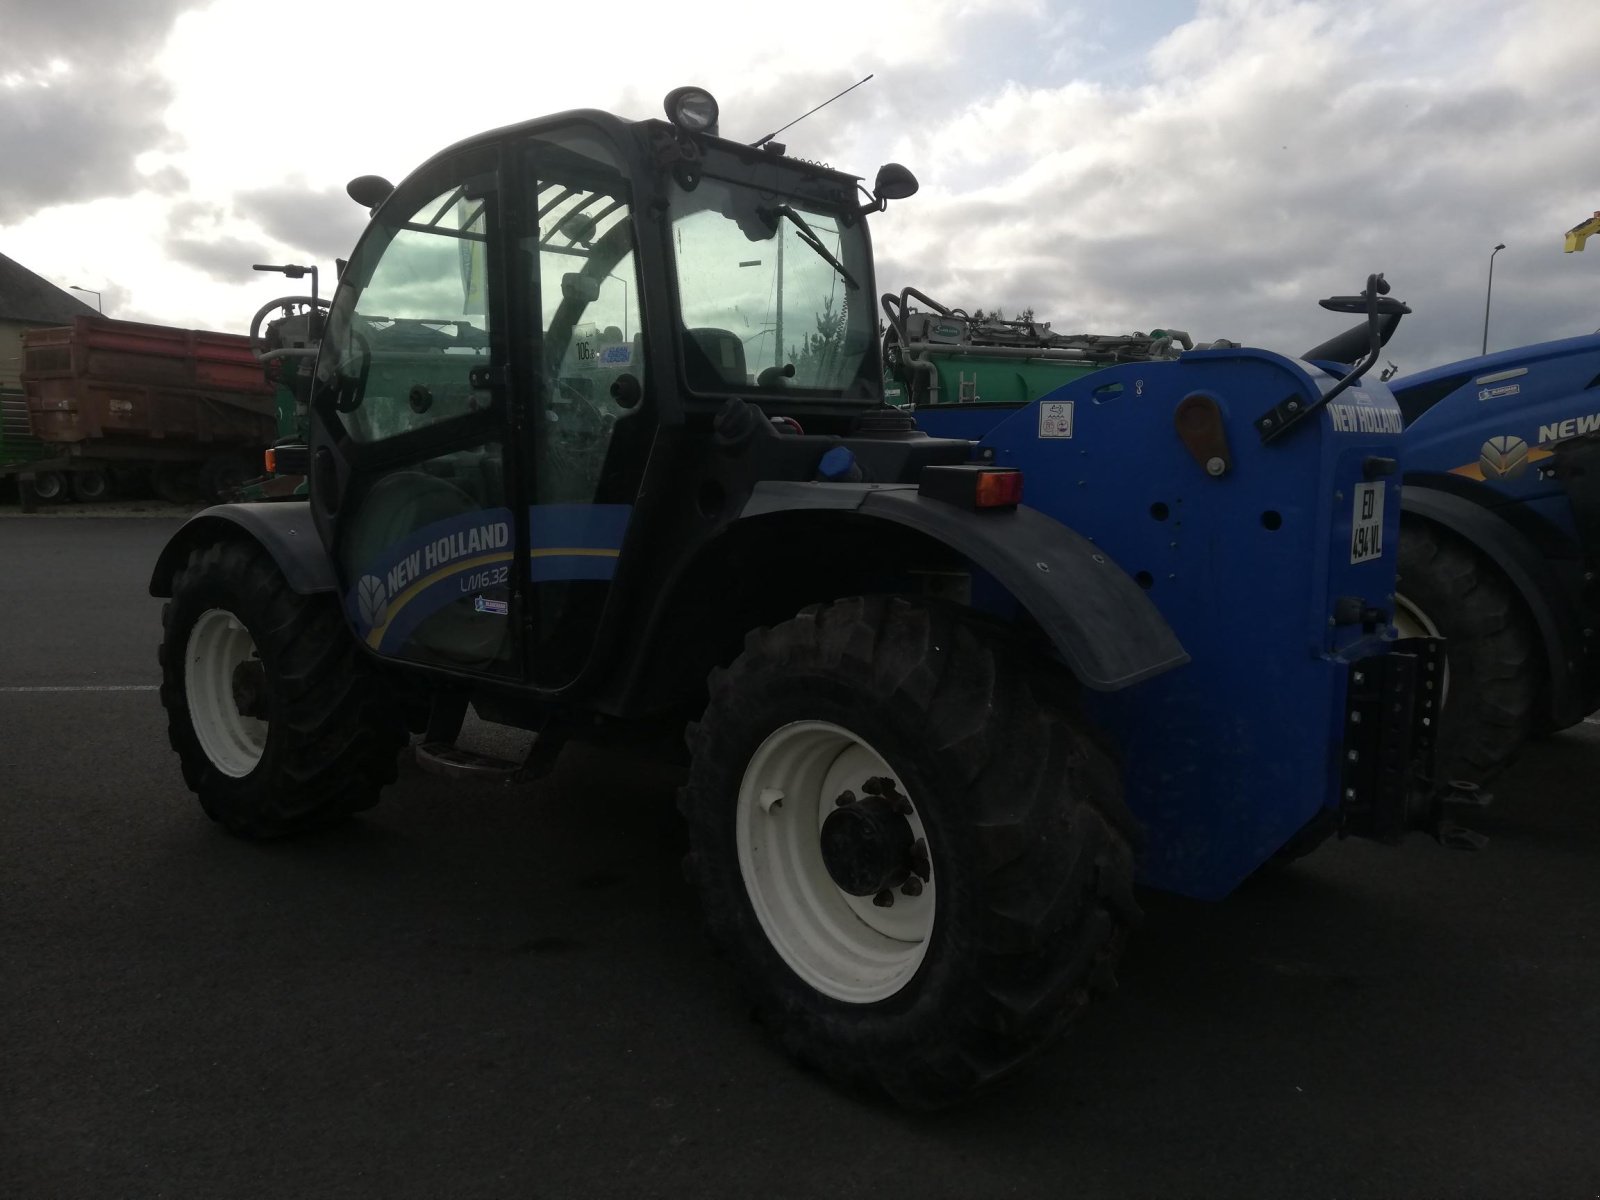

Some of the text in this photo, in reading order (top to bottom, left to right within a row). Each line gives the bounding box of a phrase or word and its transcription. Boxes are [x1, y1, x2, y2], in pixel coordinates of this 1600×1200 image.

[576, 342, 590, 360] 106
[1326, 404, 1402, 434] NEW HOLLAND
[1539, 413, 1600, 443] NEW
[1362, 489, 1375, 520] ED
[1353, 525, 1381, 559] 494 VL
[387, 522, 509, 598] NEW HOLLAND
[460, 566, 509, 592] LM6.32
